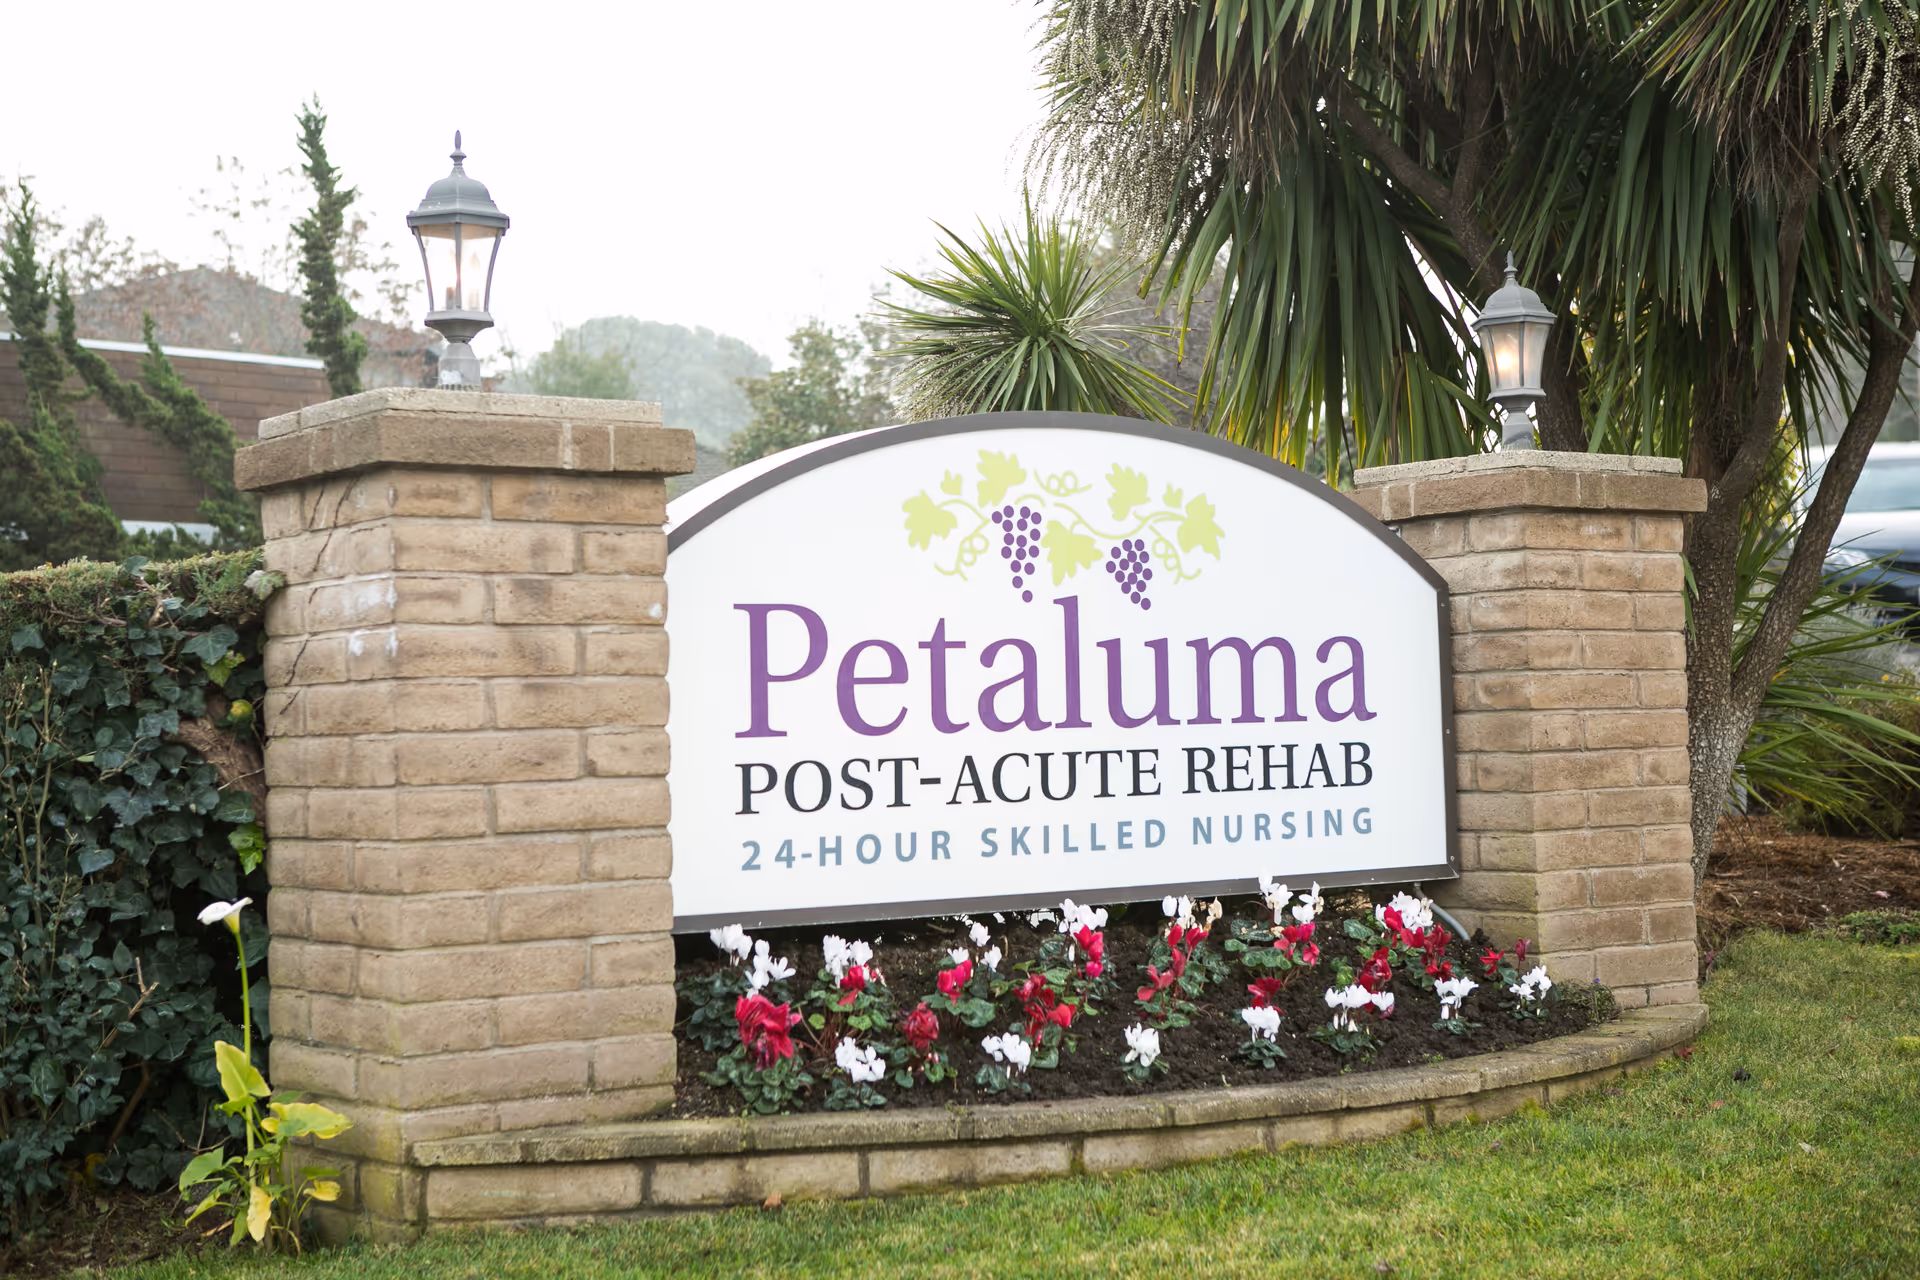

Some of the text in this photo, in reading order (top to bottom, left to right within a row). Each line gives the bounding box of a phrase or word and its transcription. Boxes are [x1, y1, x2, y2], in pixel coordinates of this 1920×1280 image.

[733, 595, 1378, 739] Petaluma
[734, 741, 1373, 816] POST-ACUTE REHAB
[741, 807, 1373, 871] 24-HOUR SKILLED NURSING
